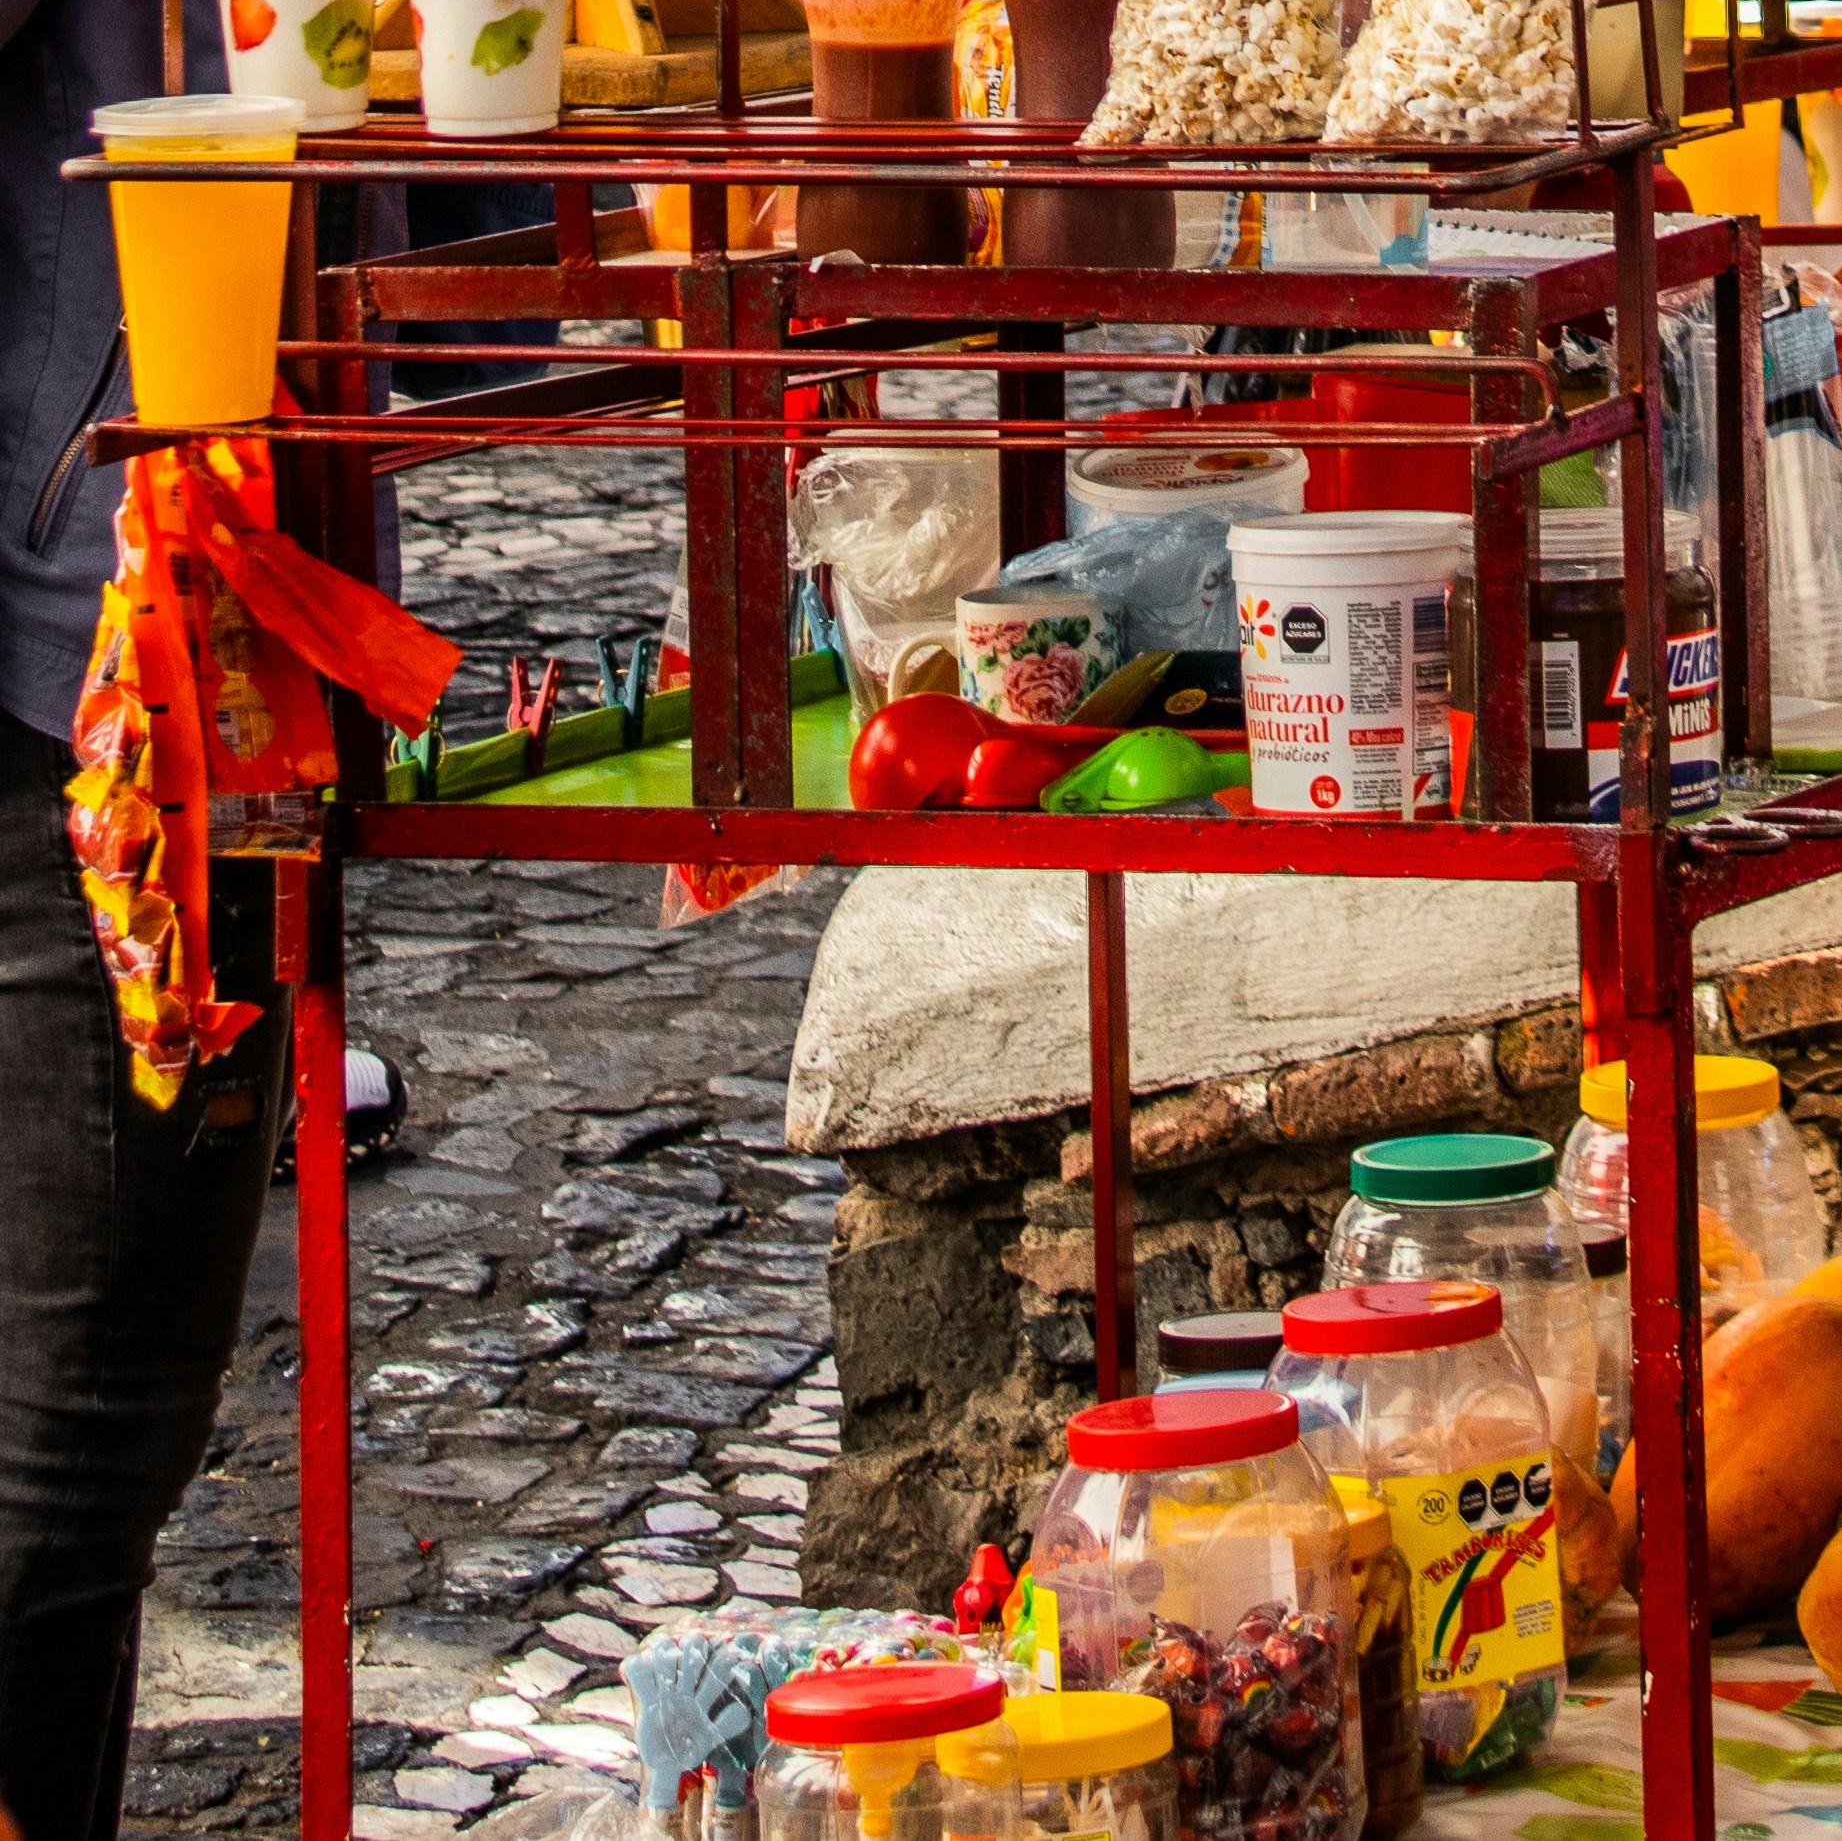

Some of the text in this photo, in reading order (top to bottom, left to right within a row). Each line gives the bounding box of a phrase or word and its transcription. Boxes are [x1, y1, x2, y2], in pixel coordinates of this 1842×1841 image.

[1247, 683, 1345, 715] durazno
[1249, 716, 1331, 744] natural
[1422, 1497, 1445, 1514] 200
